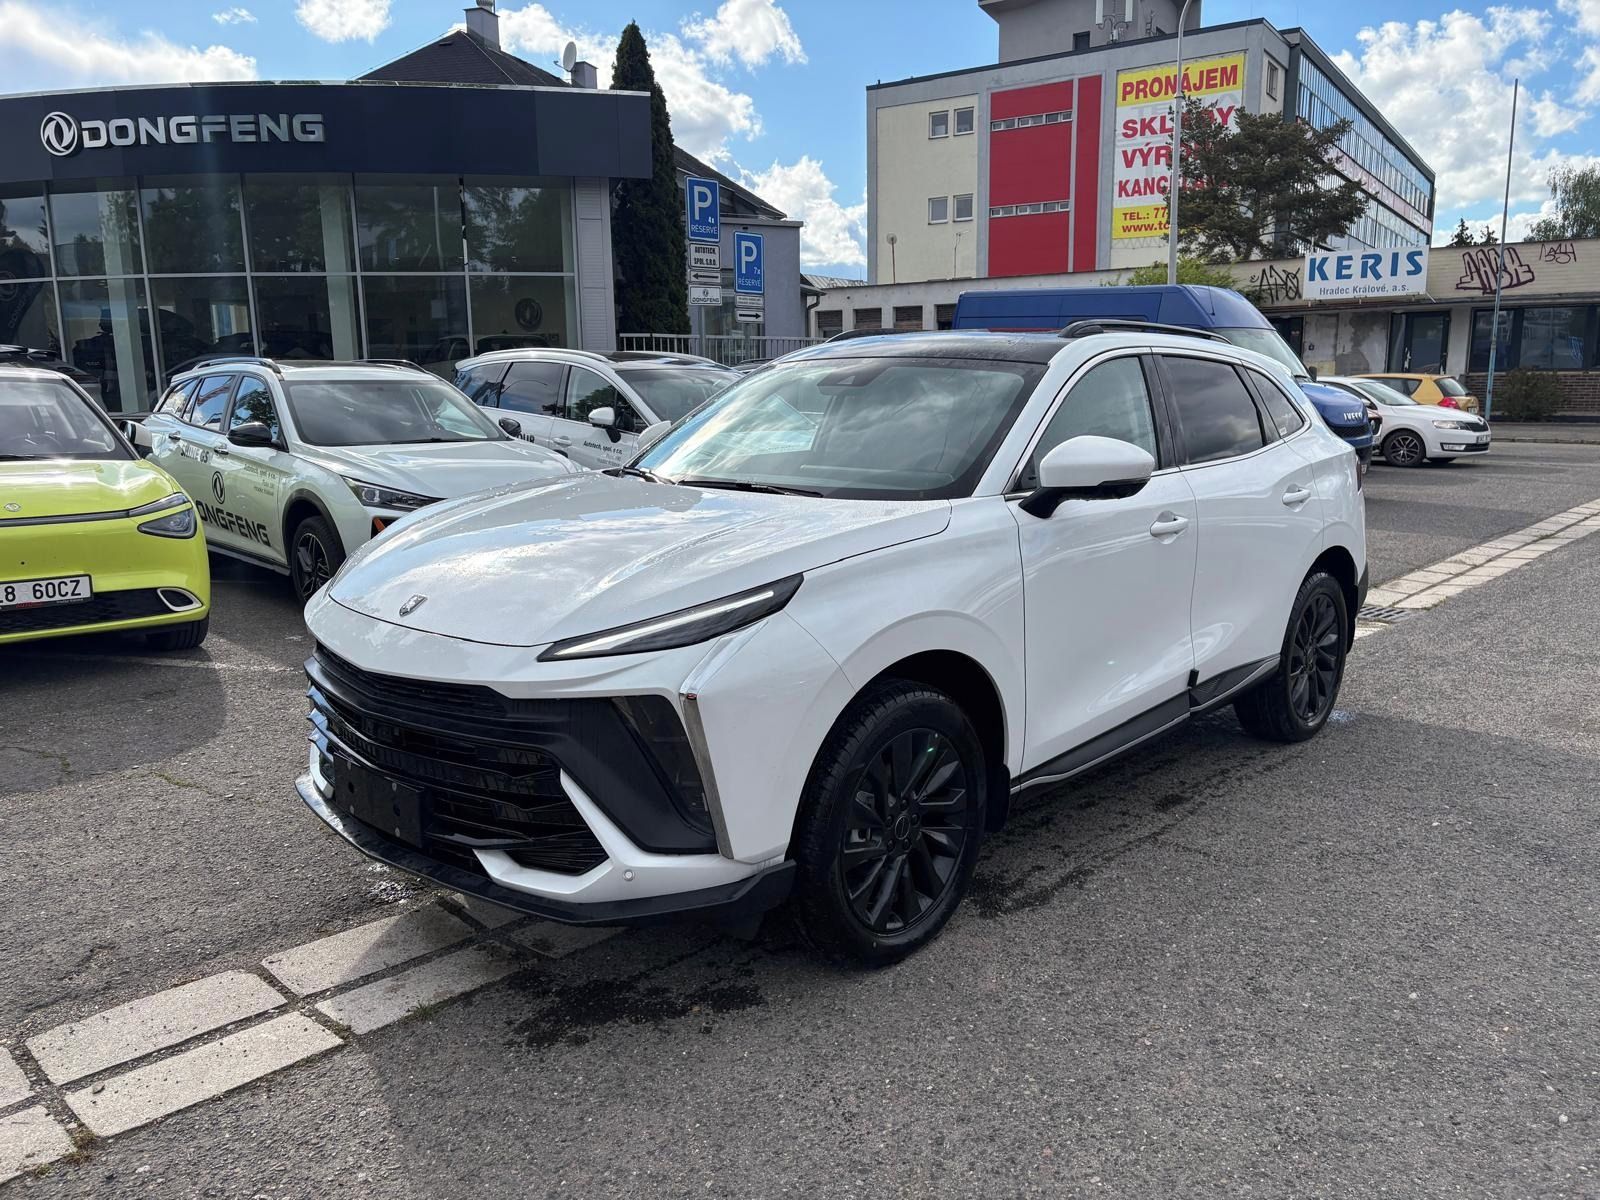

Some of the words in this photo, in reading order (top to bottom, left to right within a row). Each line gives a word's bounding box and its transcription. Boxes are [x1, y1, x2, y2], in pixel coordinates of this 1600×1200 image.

[1122, 64, 1238, 102] PRONÁJEM
[81, 113, 325, 148] DONGFENG
[1122, 106, 1235, 138] SKLY
[694, 185, 712, 221] P
[1122, 212, 1150, 221] TEL.:
[1153, 207, 1169, 219] 77
[741, 241, 757, 274] P
[1308, 250, 1424, 282] KERIS
[1319, 286, 1349, 296] Hradec
[1352, 283, 1389, 294] Králové,
[1392, 284, 1409, 292] a.s.
[195, 500, 271, 547] ONGFENG
[0, 585, 16, 604] 8
[32, 579, 81, 600] 60CZ
